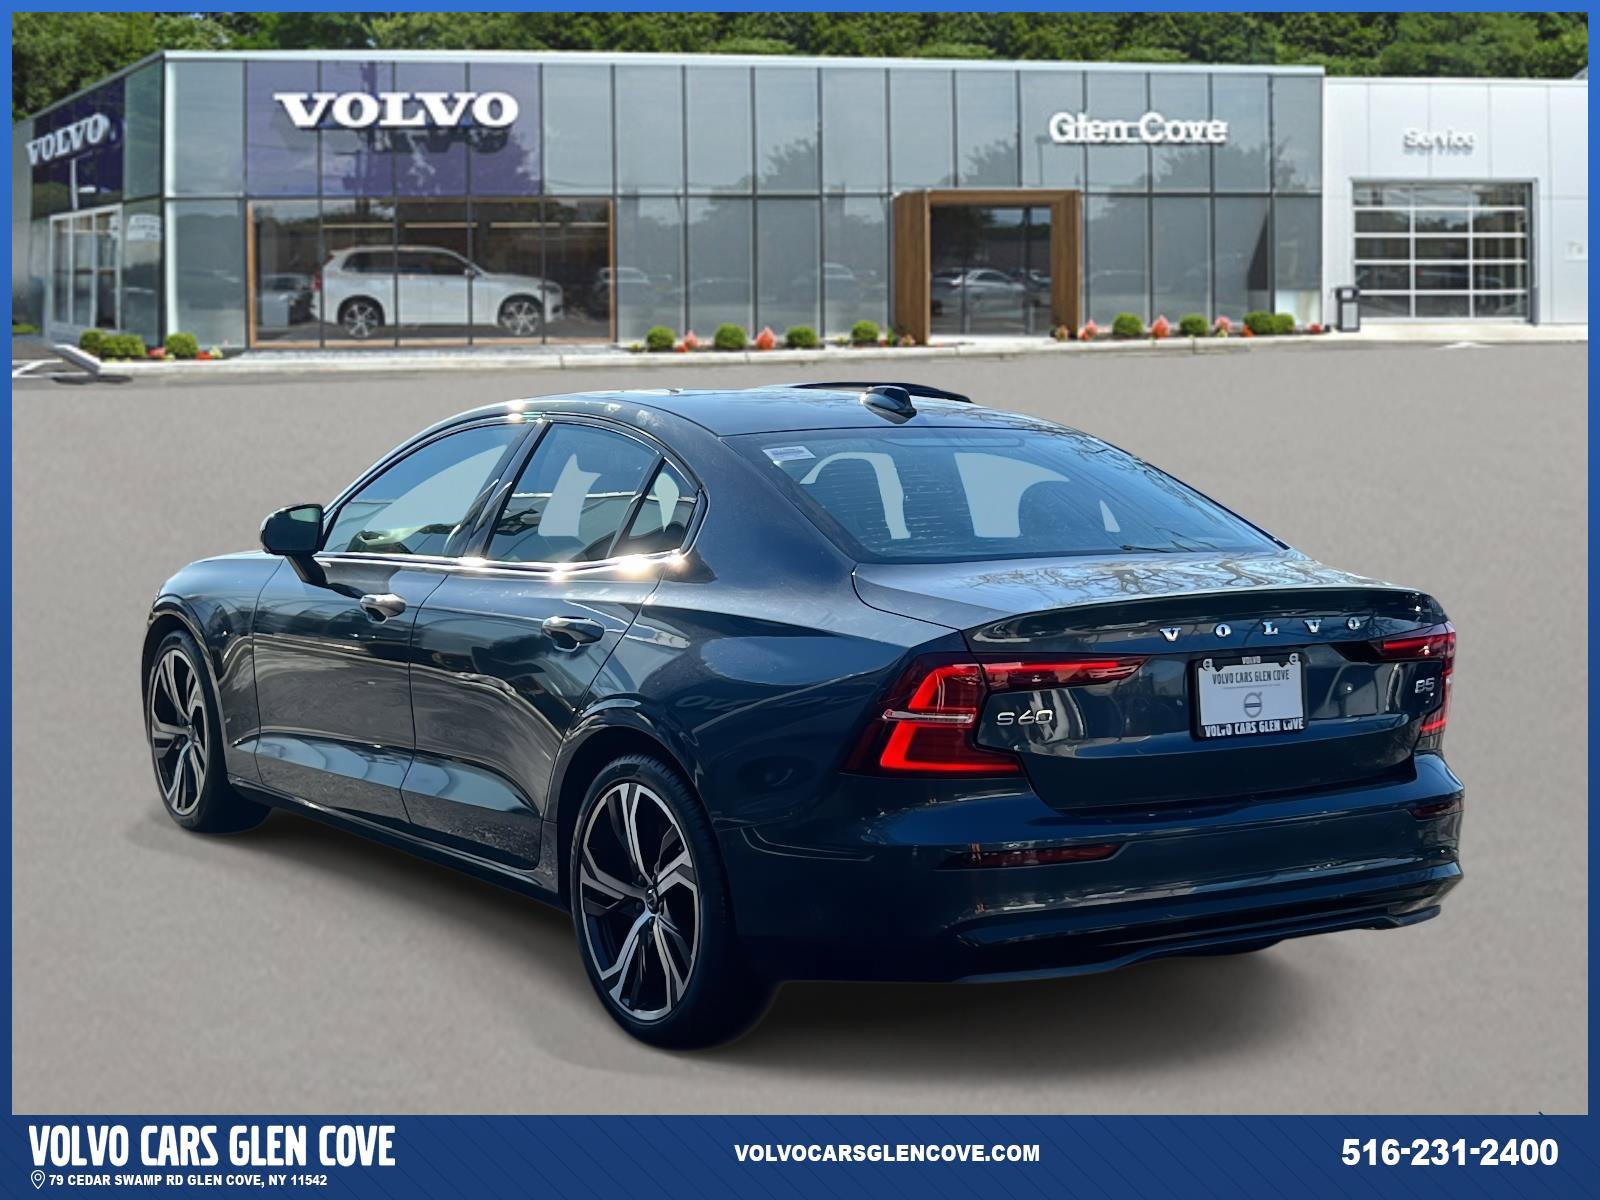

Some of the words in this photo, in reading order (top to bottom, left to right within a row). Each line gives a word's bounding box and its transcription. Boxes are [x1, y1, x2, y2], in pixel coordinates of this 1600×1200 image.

[274, 91, 519, 129] VOLVO
[1049, 111, 1131, 144] Glen
[1138, 111, 1229, 144] Cove
[25, 112, 111, 166] VOLVO
[1402, 127, 1475, 155] Service
[1160, 616, 1361, 642] VOLVO
[1242, 656, 1261, 664] VOLVO
[1212, 672, 1234, 685] VOLVO
[1235, 671, 1253, 684] CARS
[1254, 670, 1272, 682] GLEN
[1273, 669, 1290, 681] COVE
[1415, 677, 1435, 693] B5
[996, 709, 1053, 726] S60
[1204, 725, 1232, 737] VOLVO
[1234, 722, 1257, 734] CARS
[1259, 720, 1280, 733] GLEN
[1282, 718, 1304, 730] COVE
